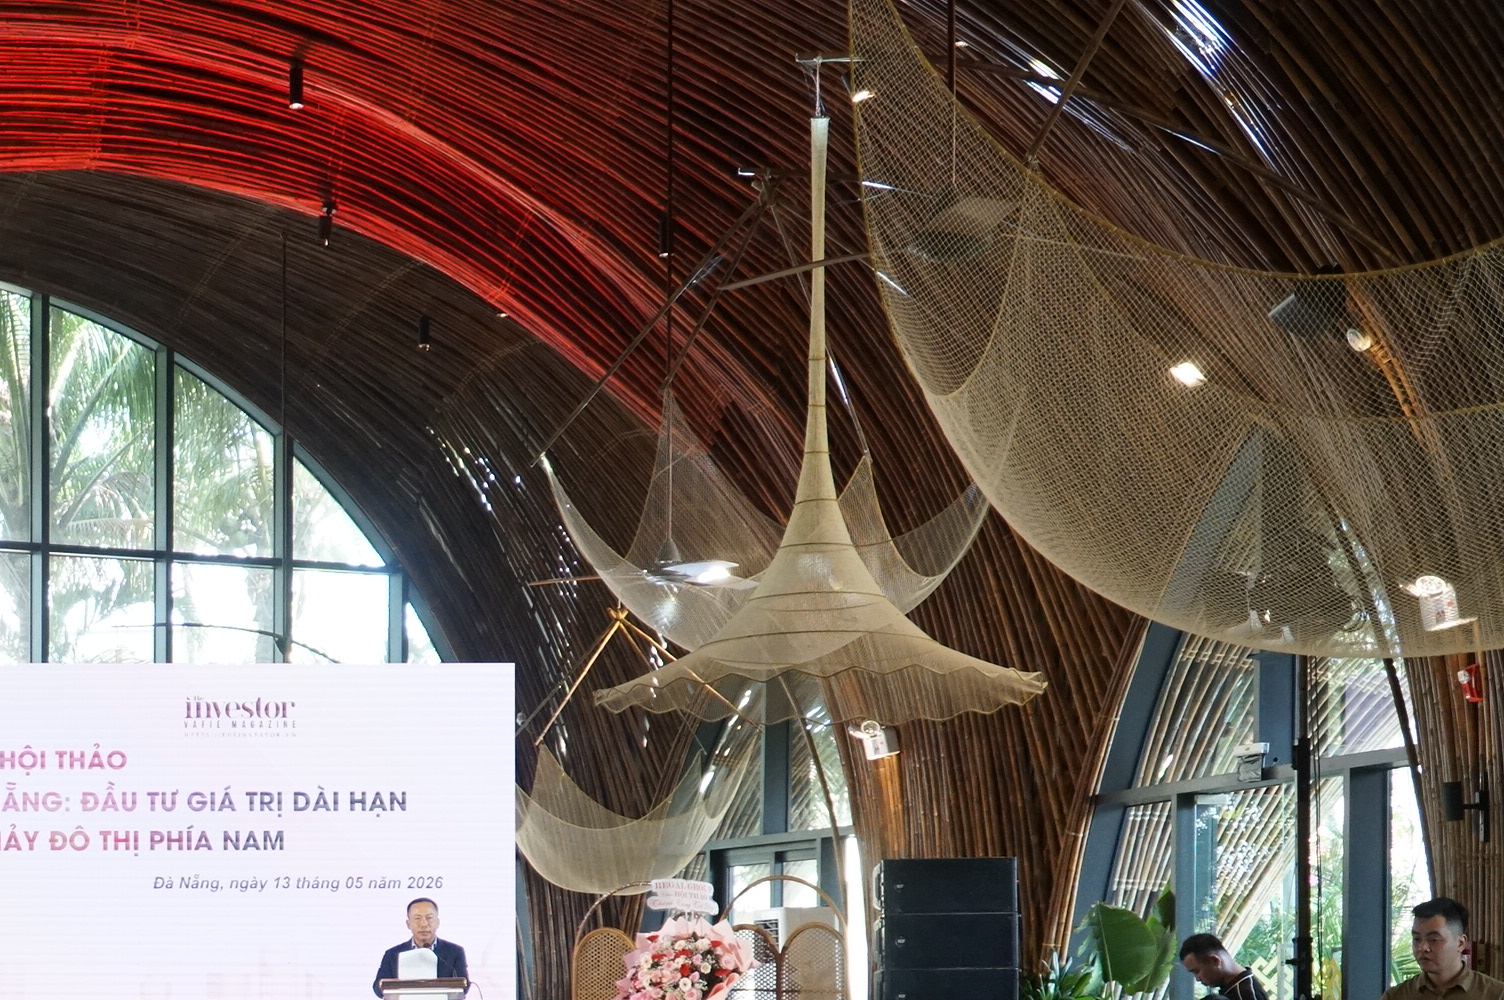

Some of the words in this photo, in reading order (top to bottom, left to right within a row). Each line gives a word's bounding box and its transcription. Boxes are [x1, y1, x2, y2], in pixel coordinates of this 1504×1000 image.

[185, 696, 296, 719] investor
[231, 720, 296, 729] MAGAZINE
[0, 744, 46, 776] HỘI
[55, 743, 128, 770] THẢO
[80, 781, 138, 812] ĐẦU
[146, 788, 180, 812] TƯ
[187, 785, 237, 812] GIÁ
[245, 791, 283, 818] TRỊ
[293, 785, 339, 812] DÀI
[349, 791, 407, 818] HẠN
[49, 825, 90, 851] ĐÔ
[99, 830, 139, 857] THỊ
[149, 824, 213, 851] PHÍA
[223, 830, 284, 851] NAM
[153, 876, 173, 890] Đà
[179, 873, 224, 893] Nẵng,
[229, 876, 267, 893] ngày
[273, 876, 291, 890] 13
[296, 876, 340, 893] tháng
[345, 876, 364, 890] 05
[368, 875, 402, 890] năm
[407, 876, 444, 890] 2026
